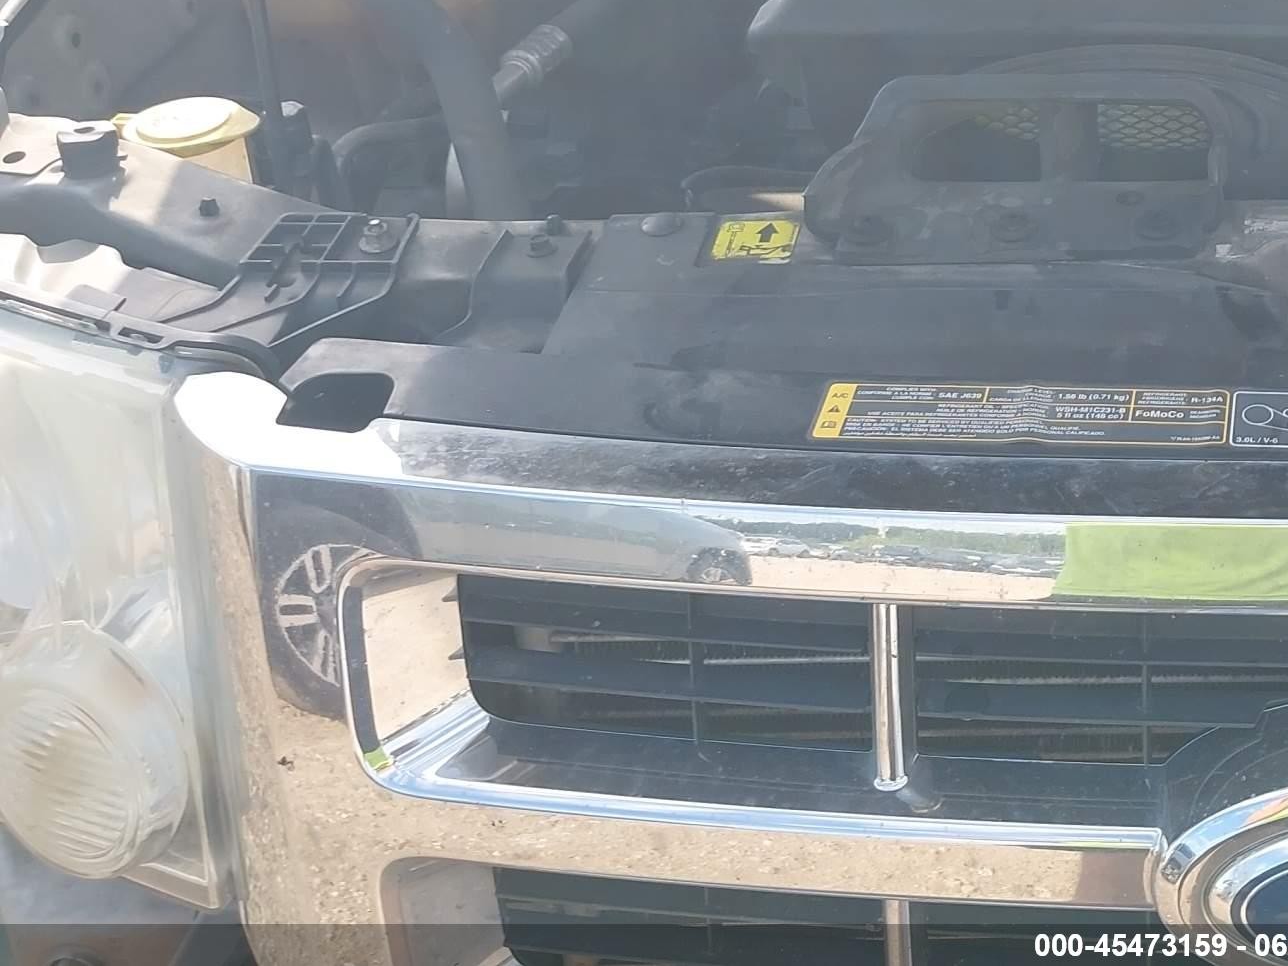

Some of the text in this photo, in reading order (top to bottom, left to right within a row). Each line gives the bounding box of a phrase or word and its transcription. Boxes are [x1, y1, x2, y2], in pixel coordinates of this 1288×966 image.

[1113, 393, 1129, 402] kg)
[1191, 395, 1224, 403] R-134A
[1135, 409, 1185, 419] FoMoCo
